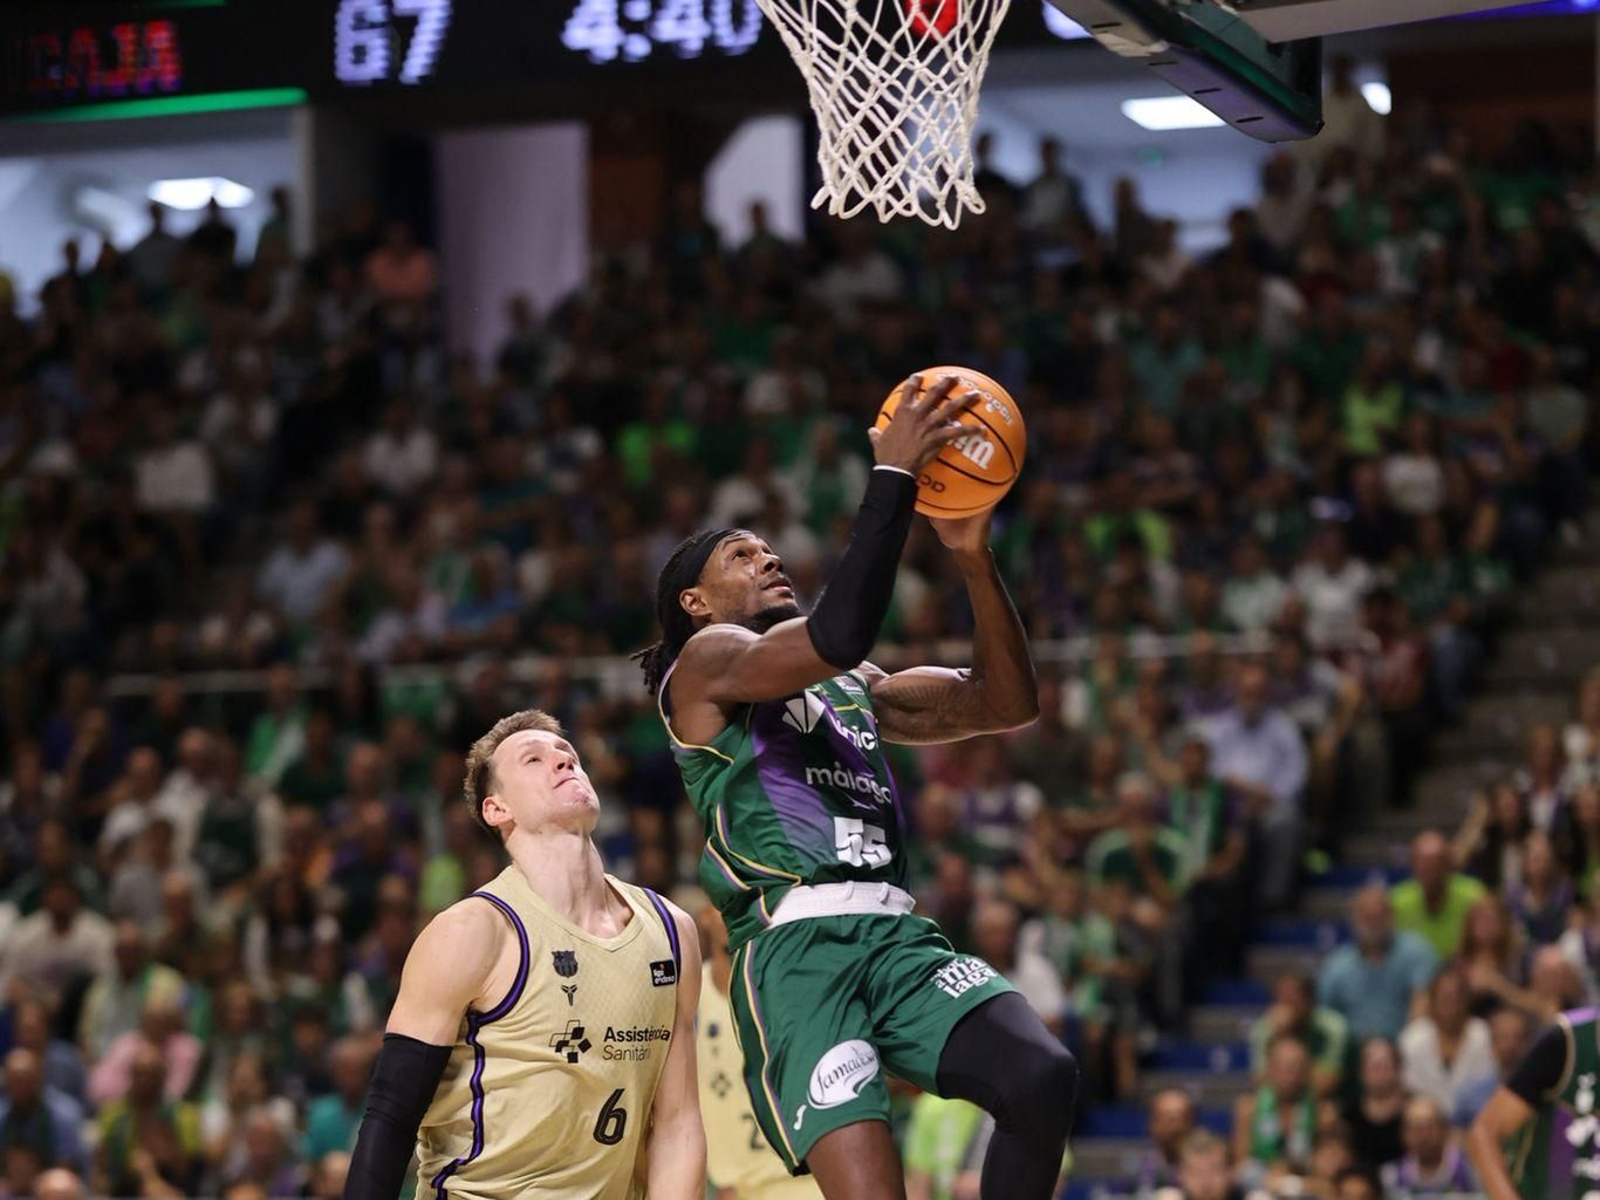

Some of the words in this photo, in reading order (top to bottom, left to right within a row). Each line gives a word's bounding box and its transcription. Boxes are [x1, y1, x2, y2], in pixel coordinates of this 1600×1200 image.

[334, 0, 452, 84] 67
[561, 0, 763, 63] 4:40
[917, 473, 947, 494] ac
[834, 816, 892, 870] 55
[593, 1088, 627, 1145] 6
